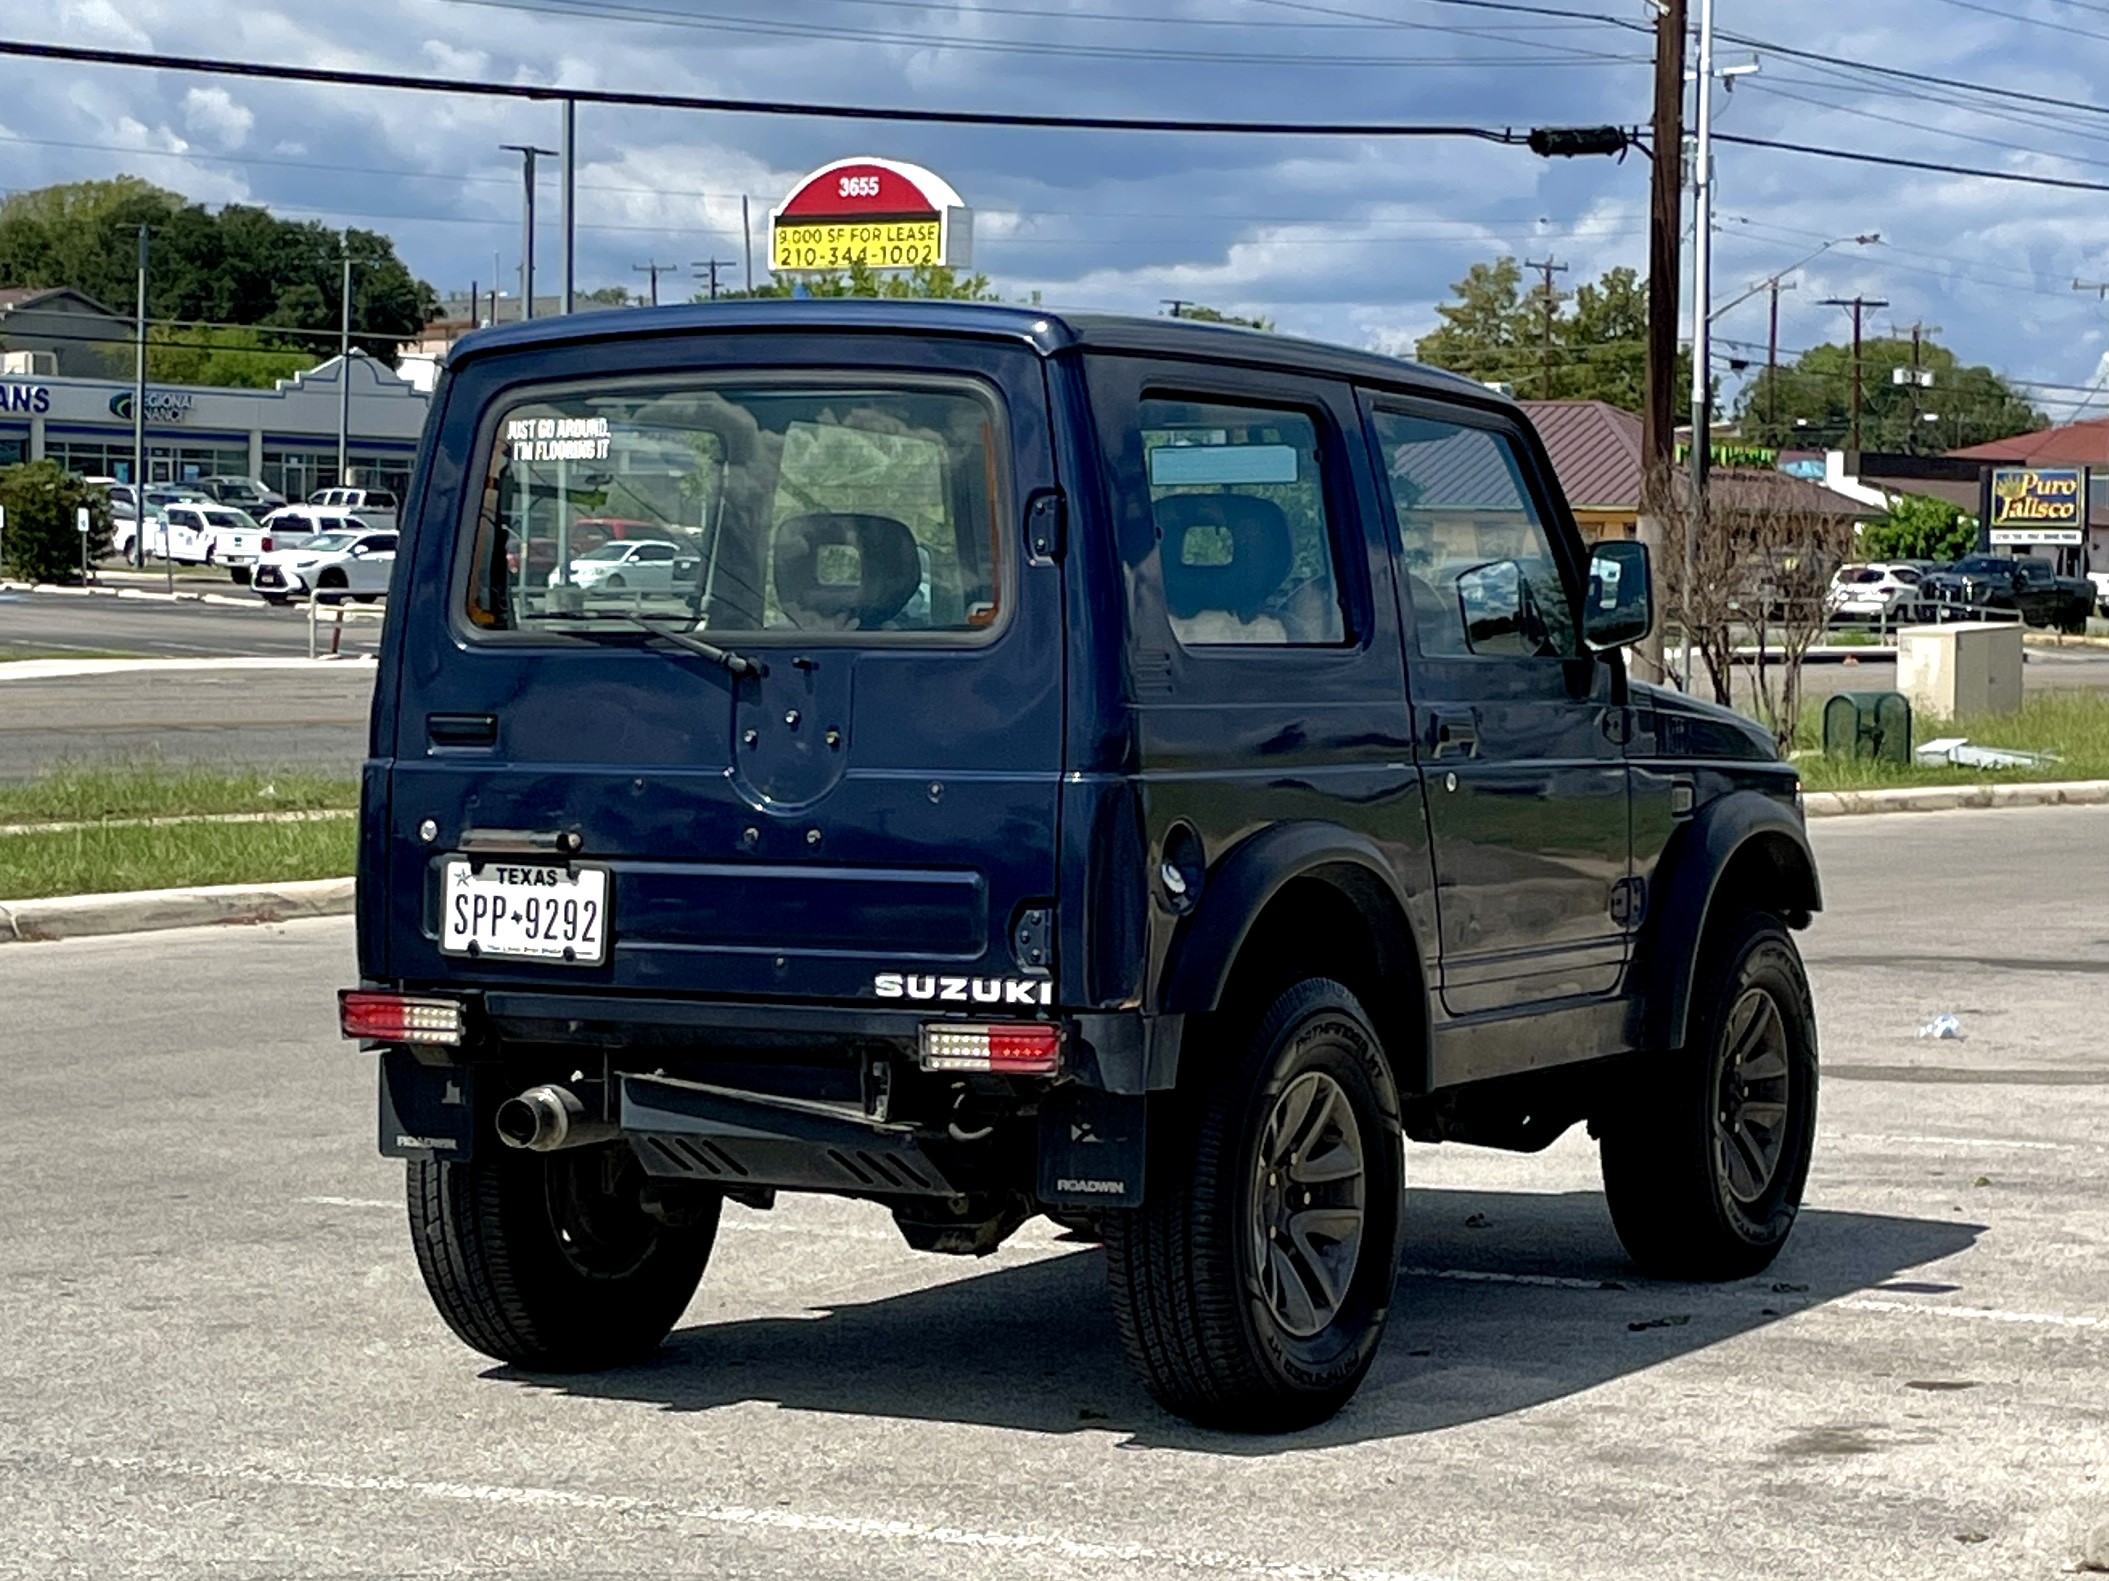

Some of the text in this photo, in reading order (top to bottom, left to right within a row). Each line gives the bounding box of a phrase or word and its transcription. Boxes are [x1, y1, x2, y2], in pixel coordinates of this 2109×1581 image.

[838, 176, 880, 197] 3655
[828, 228, 845, 243] SF
[850, 227, 882, 243] FOR
[887, 225, 936, 242] LEASE
[781, 245, 932, 266] 210-344-1002
[507, 420, 536, 439] JUST
[538, 419, 555, 438] GO
[514, 439, 610, 460] I'M FLOORING IT
[2021, 473, 2077, 496] Puro
[1996, 496, 2075, 524] Jalisco
[496, 867, 559, 886] TEXAS
[874, 972, 1052, 1005] SUZUKI
[1057, 1179, 1125, 1194] ROADWIN
